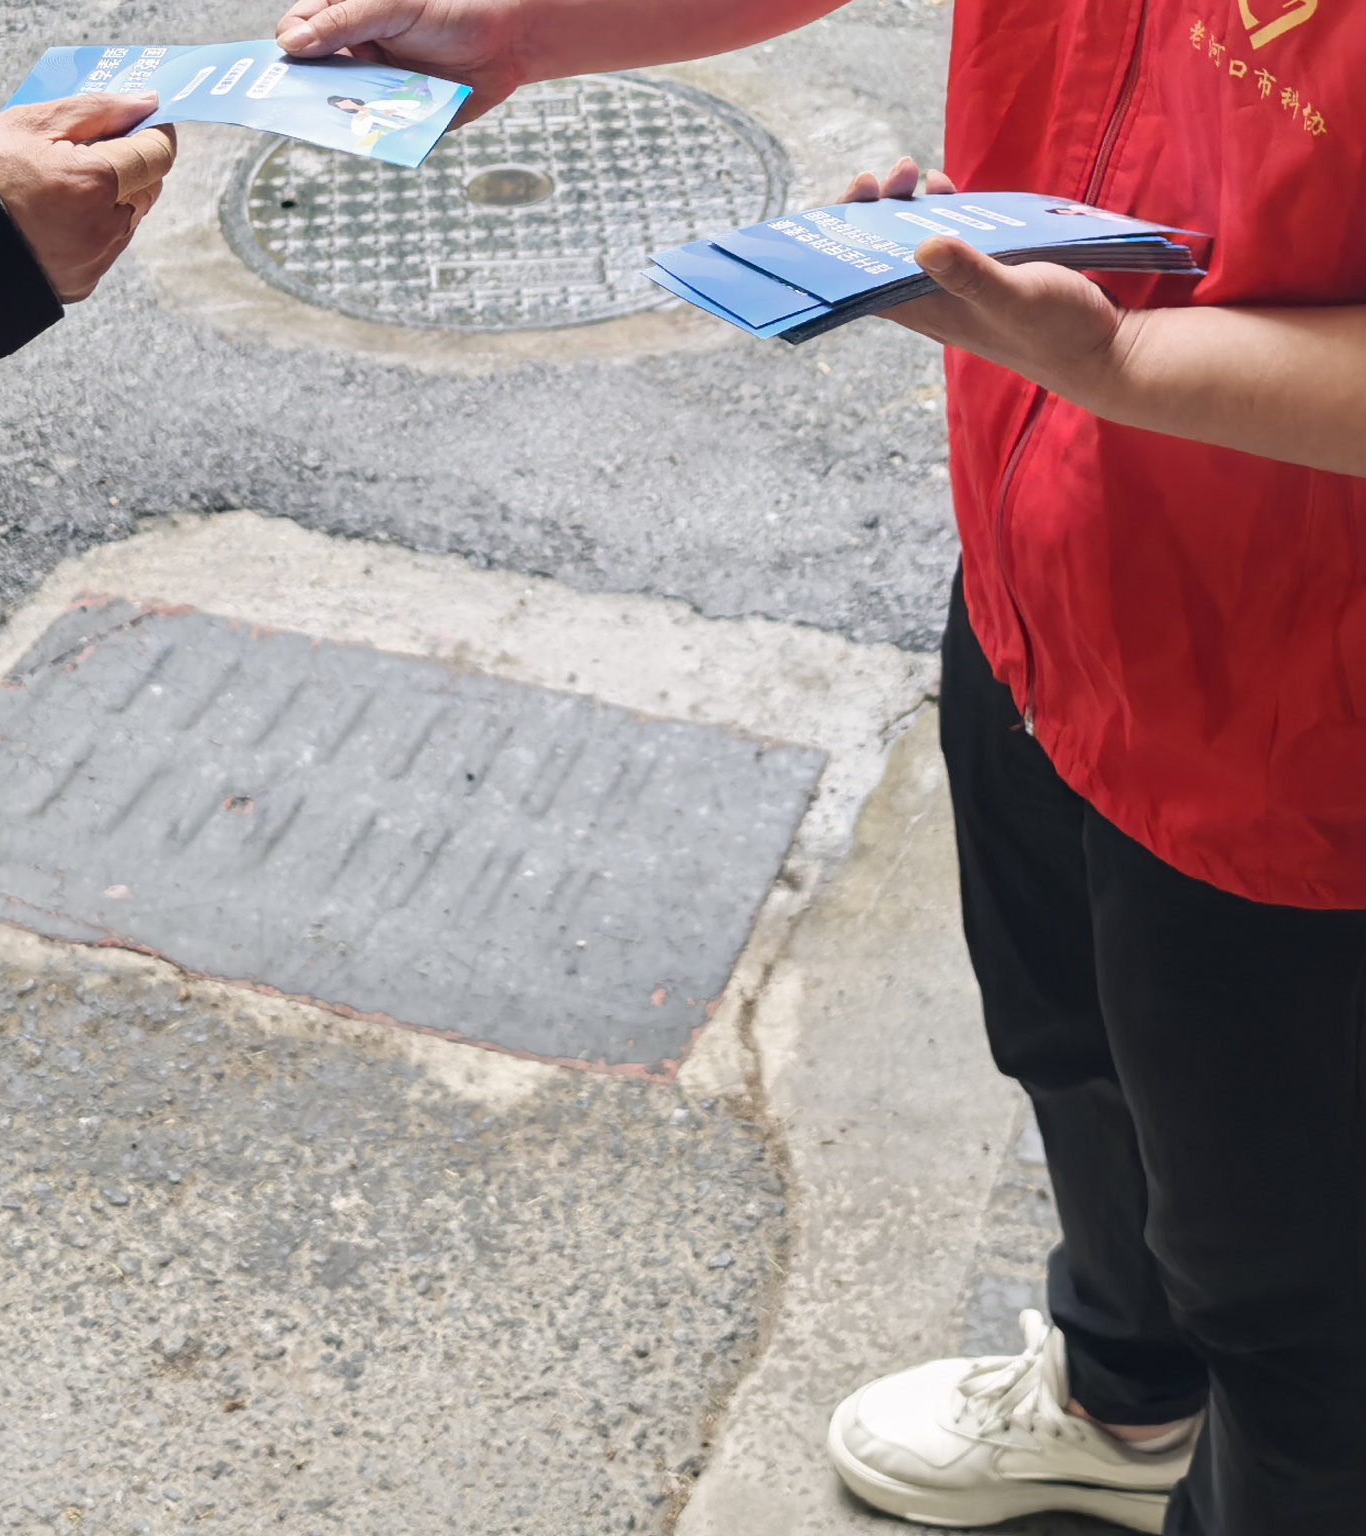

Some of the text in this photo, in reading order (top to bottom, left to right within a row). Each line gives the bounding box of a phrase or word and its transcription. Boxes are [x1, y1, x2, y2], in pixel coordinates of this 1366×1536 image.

[1189, 19, 1327, 135] 老河口市科协
